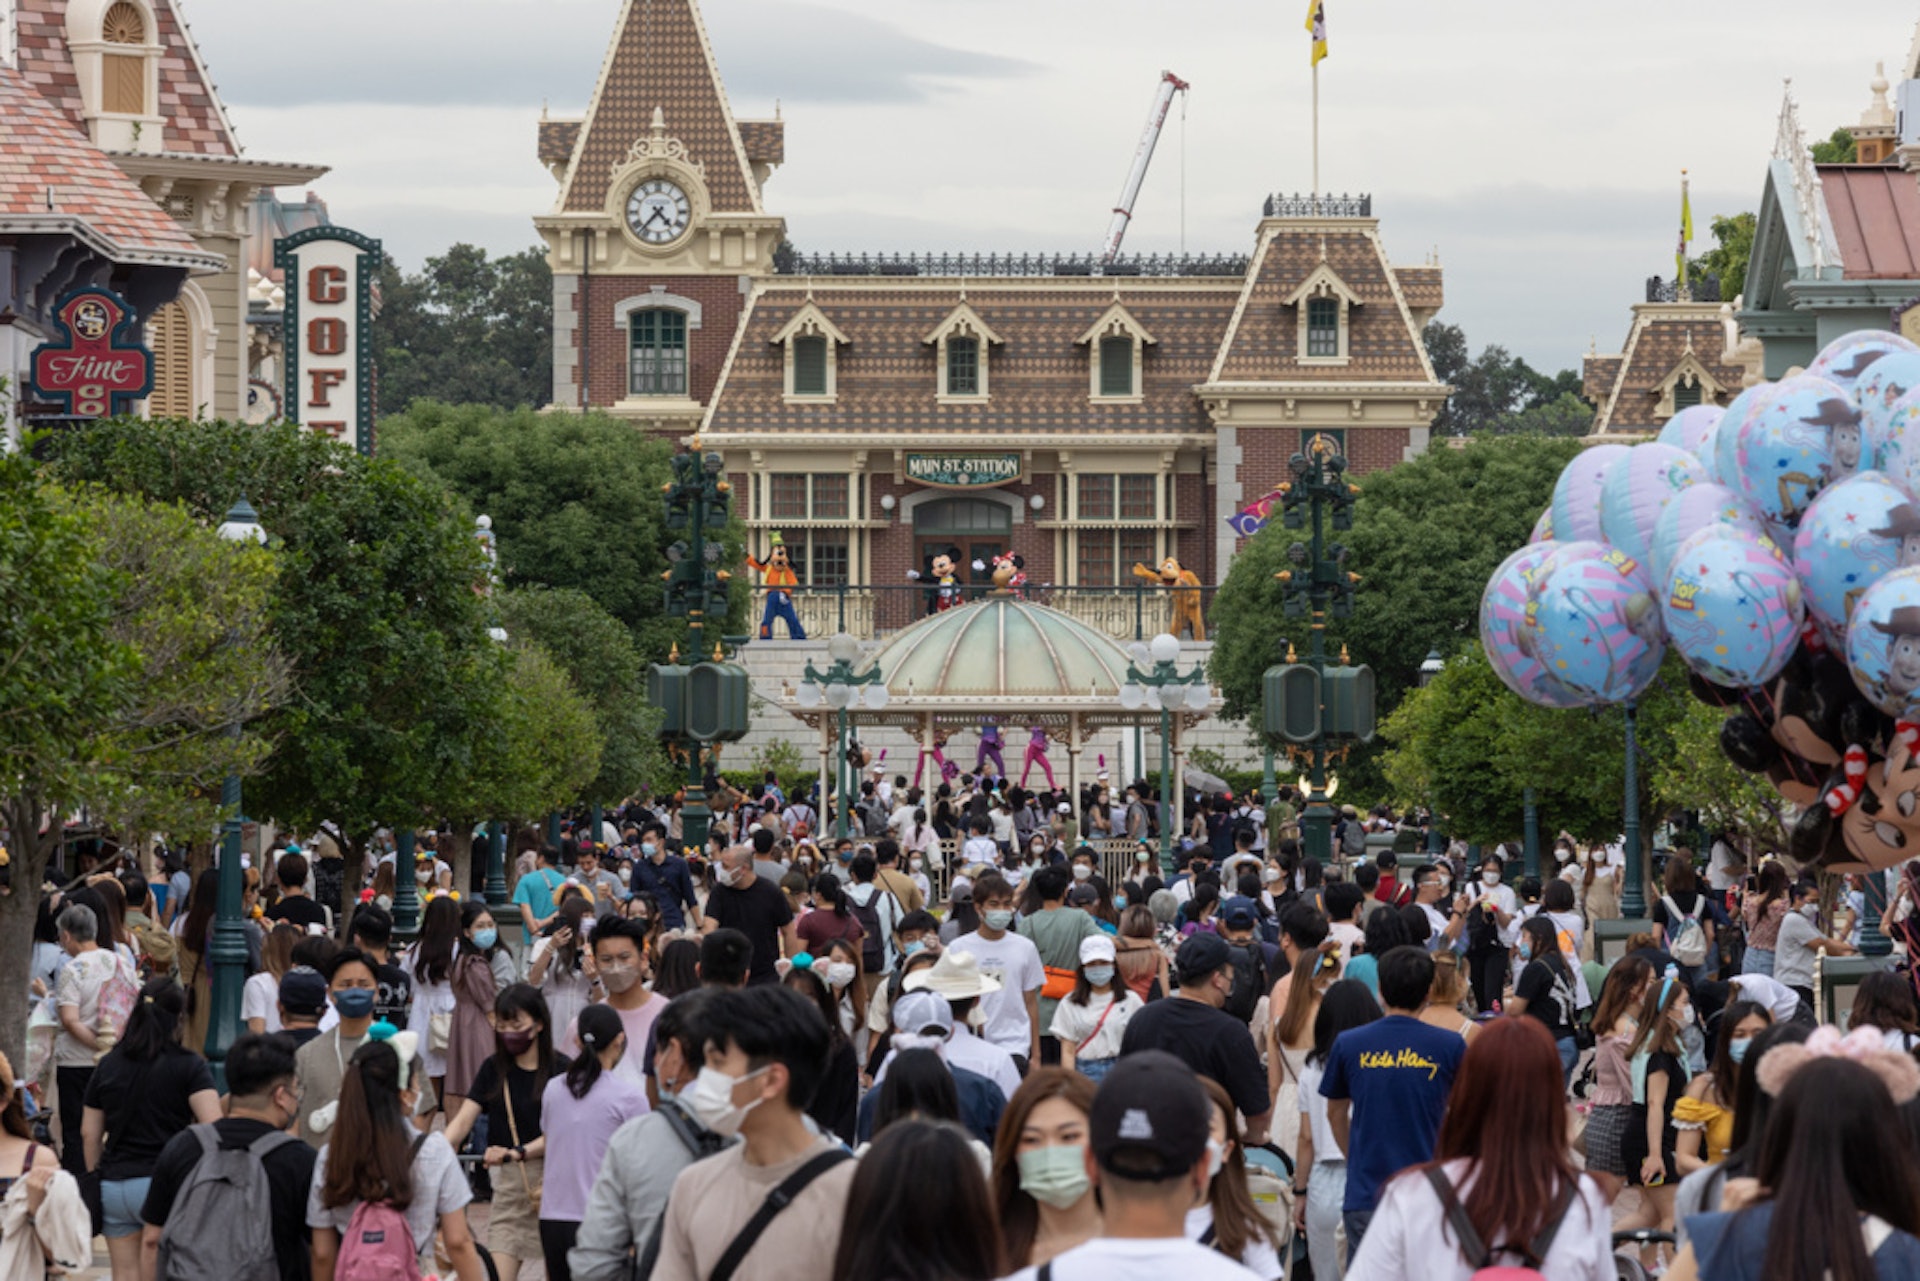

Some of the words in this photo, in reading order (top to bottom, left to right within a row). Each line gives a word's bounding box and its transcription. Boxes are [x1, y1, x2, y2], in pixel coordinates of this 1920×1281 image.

[49, 355, 136, 384] Fine
[910, 459, 940, 475] MAIN
[963, 459, 1018, 475] STATION
[1674, 577, 1701, 600] TOY
